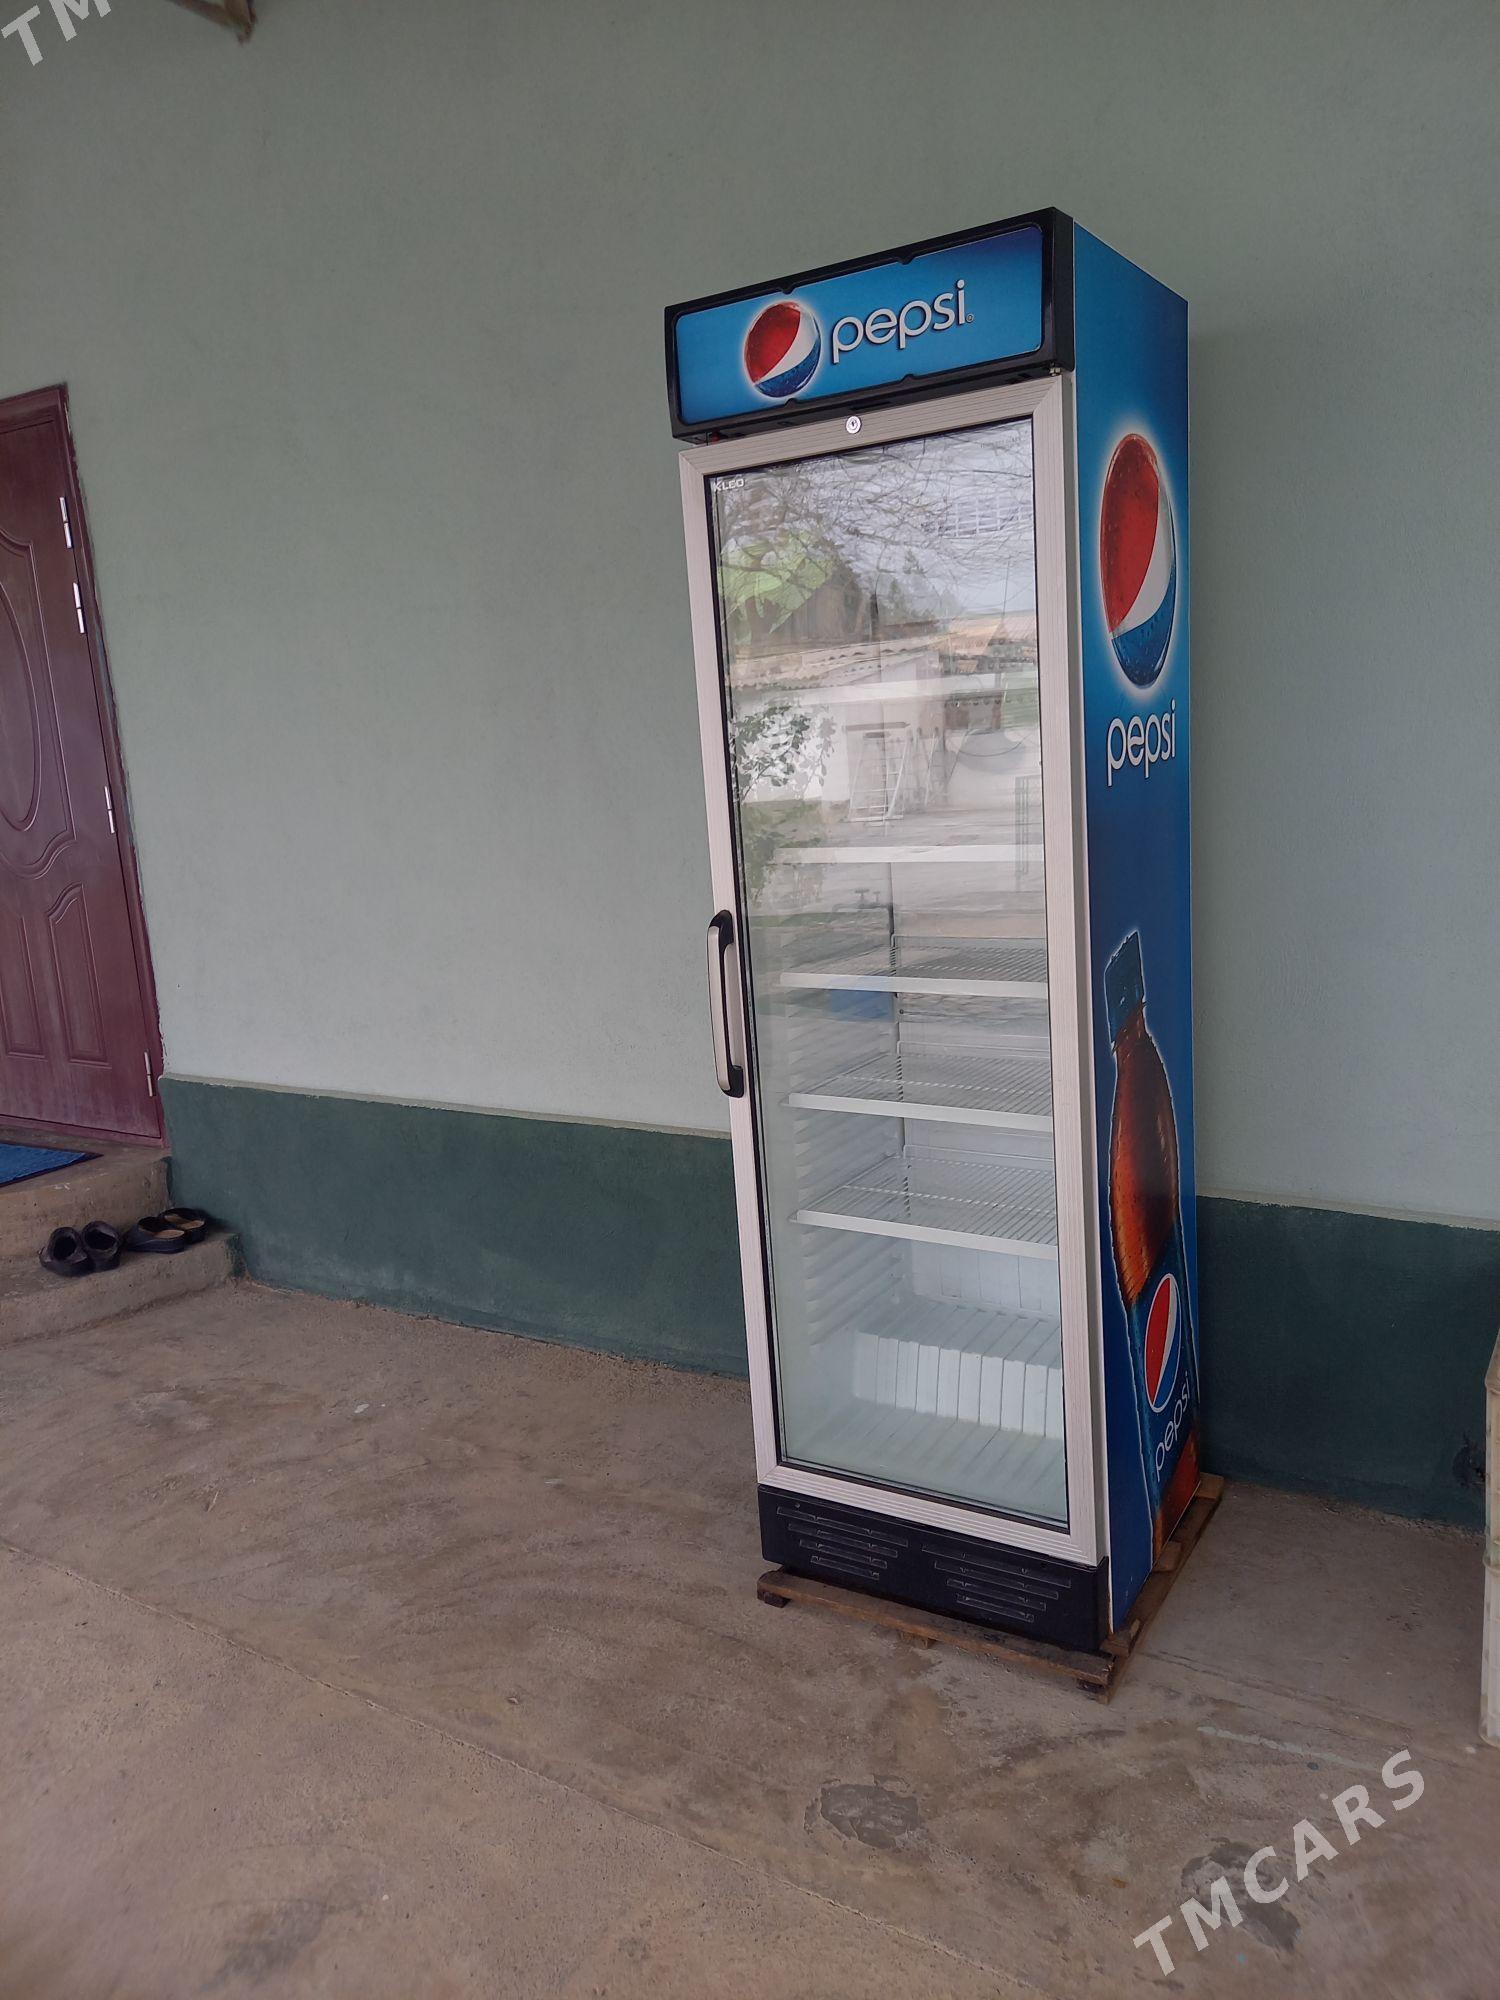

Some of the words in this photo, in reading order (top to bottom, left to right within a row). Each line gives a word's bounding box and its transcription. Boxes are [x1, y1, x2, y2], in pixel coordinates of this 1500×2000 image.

[832, 279, 966, 364] pepsi
[713, 478, 744, 492] KLEO
[1107, 699, 1176, 787] pepsi
[1155, 1370, 1190, 1482] pepsi
